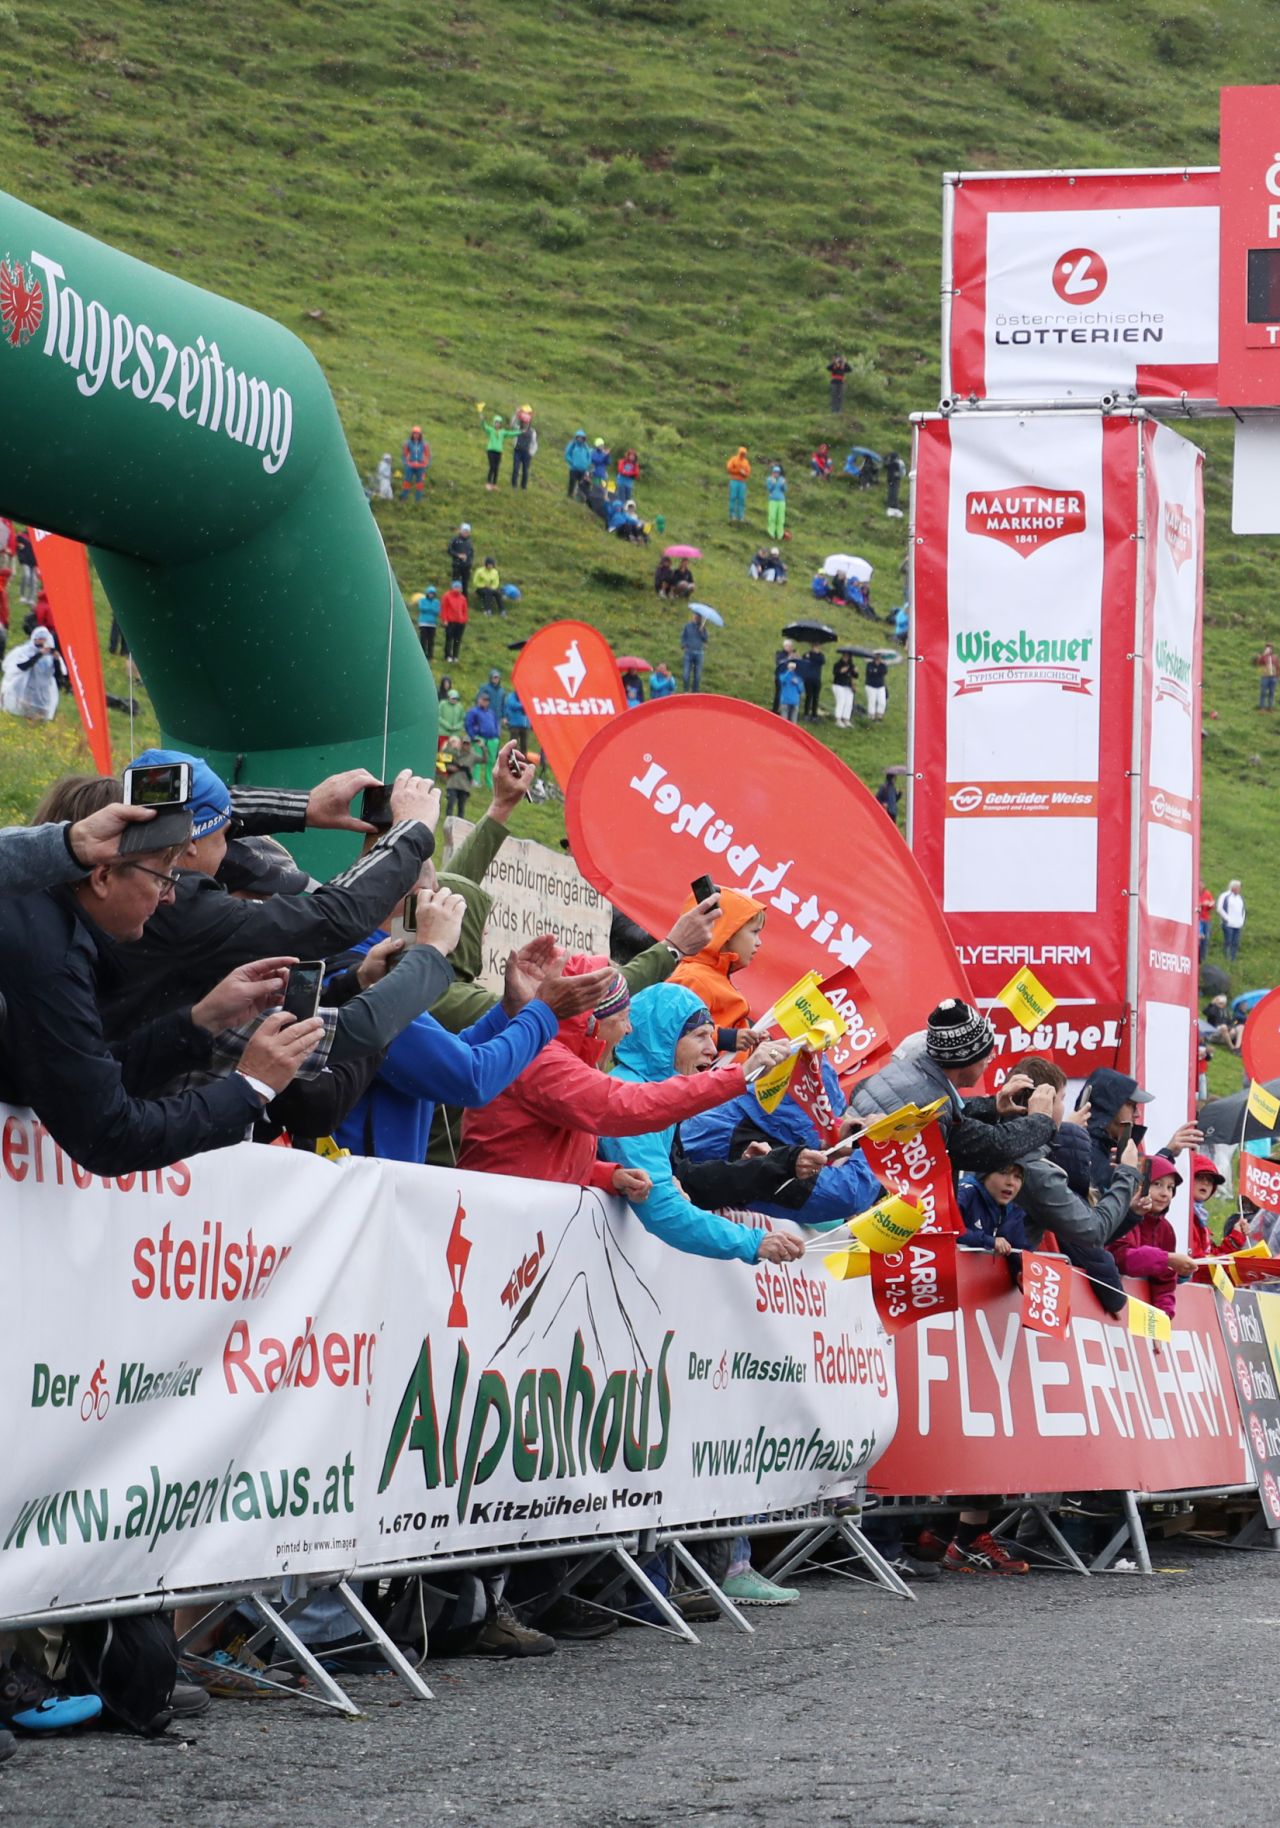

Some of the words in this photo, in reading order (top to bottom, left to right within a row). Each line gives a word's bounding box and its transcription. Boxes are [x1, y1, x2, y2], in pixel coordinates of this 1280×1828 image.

[995, 311, 1164, 326] österreichische
[995, 328, 1164, 345] LOTTERIEN
[31, 250, 293, 474] Tageszeitung
[970, 496, 1081, 515] MAUTNER
[986, 517, 1064, 530] MARKHOF
[1014, 534, 1038, 544] 1841
[956, 630, 1093, 665] Wiesbauer
[967, 671, 1006, 683] TYPISCH
[985, 792, 1050, 804] Gebrüder
[1051, 792, 1093, 804] Weiss
[488, 902, 518, 932] Kids
[522, 909, 593, 951] Kletterpfad
[824, 987, 877, 1051] ARBÖ
[1008, 1020, 1123, 1057] bühel
[1252, 1185, 1279, 1206] 1-2-3
[872, 1209, 914, 1239] esbauer
[131, 1220, 292, 1302] steilster
[909, 1246, 945, 1309] ARBÖ
[755, 1262, 828, 1318] steilster
[885, 1274, 907, 1318] 1-2-3
[1028, 1280, 1041, 1320] 1-2-3
[1041, 1266, 1061, 1327] ARBÖ
[1236, 1302, 1263, 1344] fresh
[31, 1361, 80, 1408] Der
[115, 1360, 203, 1405] Klassiker
[688, 1350, 713, 1382] Der
[731, 1350, 807, 1384] Klassiker
[813, 1330, 888, 1398] Radberg
[917, 1307, 1233, 1440] FLYERALARM
[1249, 1360, 1277, 1400] fresh
[691, 1425, 877, 1485] www.alpenhaus.at
[377, 1512, 427, 1535] 1.670
[431, 1513, 450, 1528] m
[470, 1492, 607, 1525] Kitzbüheler
[612, 1488, 663, 1508] Horn
[276, 1539, 301, 1557] printed
